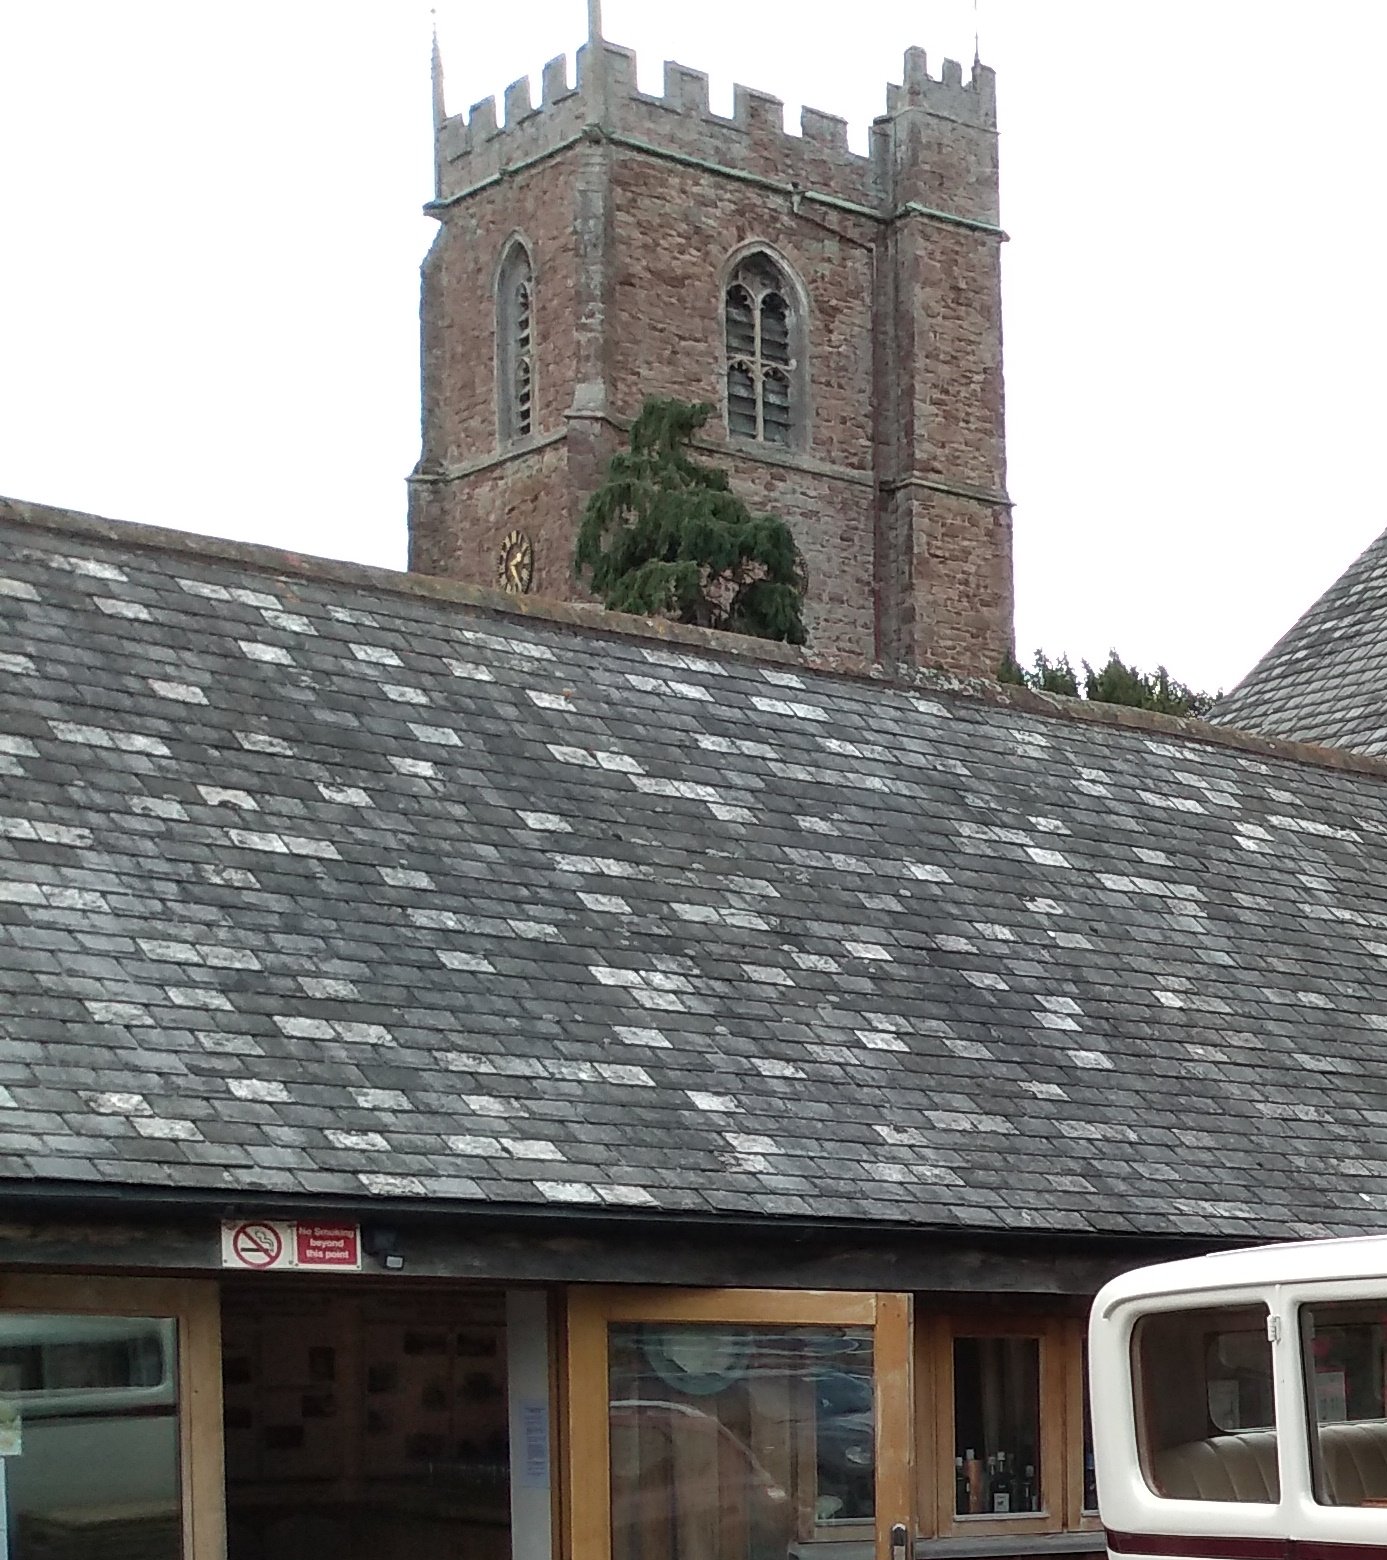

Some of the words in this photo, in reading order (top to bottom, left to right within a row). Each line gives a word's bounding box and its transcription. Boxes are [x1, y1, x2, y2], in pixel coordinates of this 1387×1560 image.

[298, 1227, 312, 1235] No
[314, 1227, 354, 1238] Smoking
[310, 1238, 344, 1248] beyond
[306, 1249, 323, 1258] this
[325, 1250, 349, 1259] point
